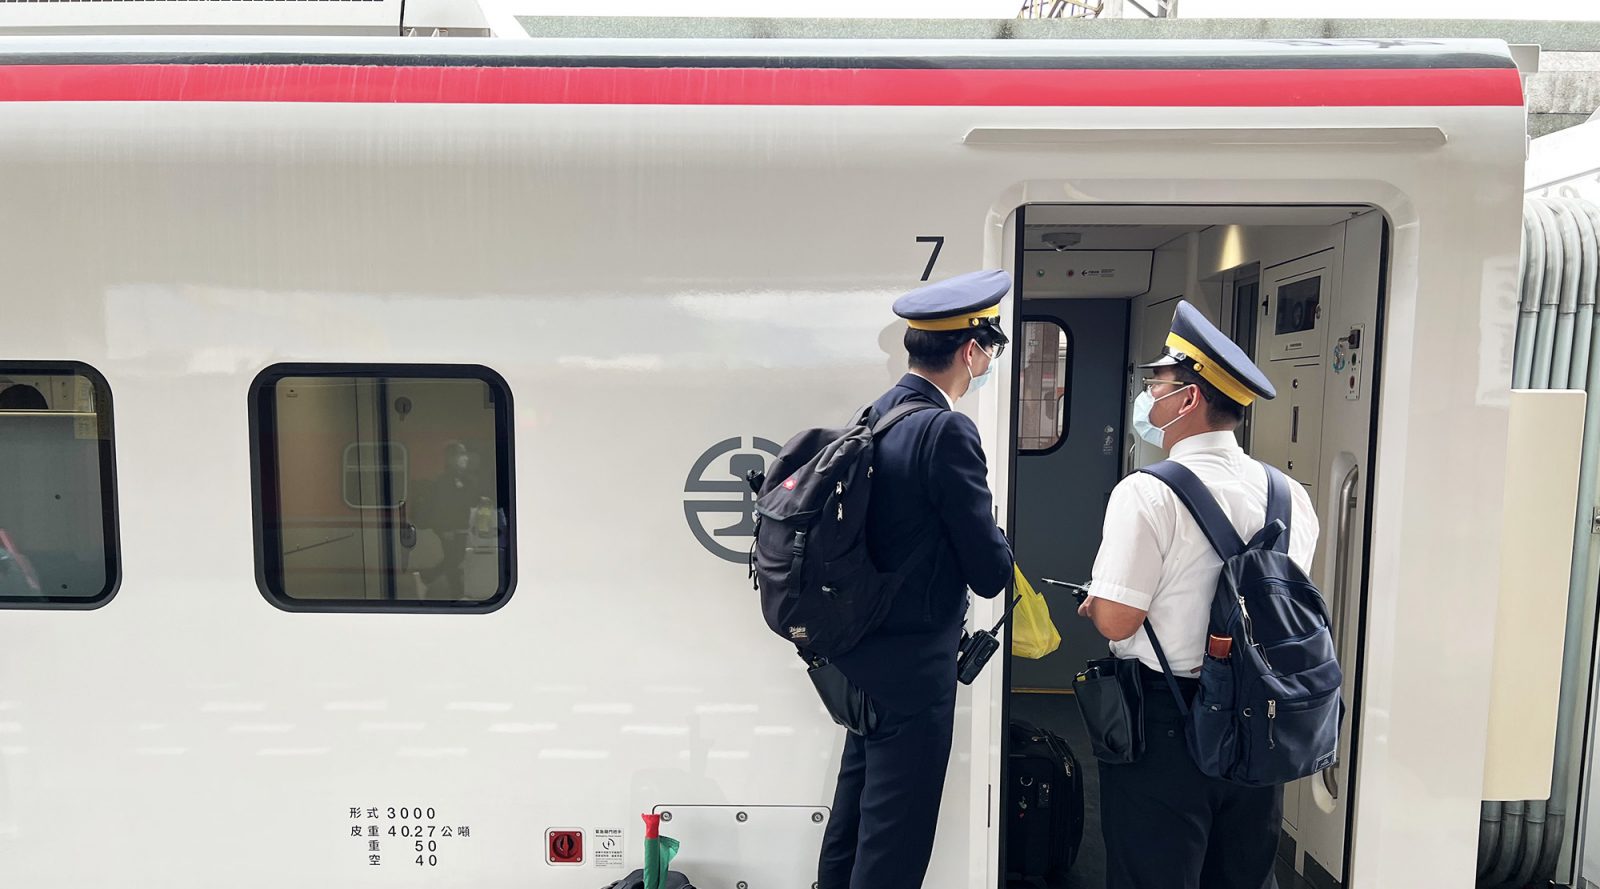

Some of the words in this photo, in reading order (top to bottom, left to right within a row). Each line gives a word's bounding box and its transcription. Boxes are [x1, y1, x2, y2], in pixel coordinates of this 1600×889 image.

[915, 236, 945, 281] 7
[349, 807, 379, 819] 形式
[387, 807, 436, 819] 3000
[350, 825, 380, 837] 皮重
[387, 825, 436, 837] 40.27
[440, 825, 470, 838] 公噸
[368, 840, 380, 852] 重
[414, 840, 437, 852] 50
[368, 854, 381, 866] 空
[415, 854, 437, 867] 40
